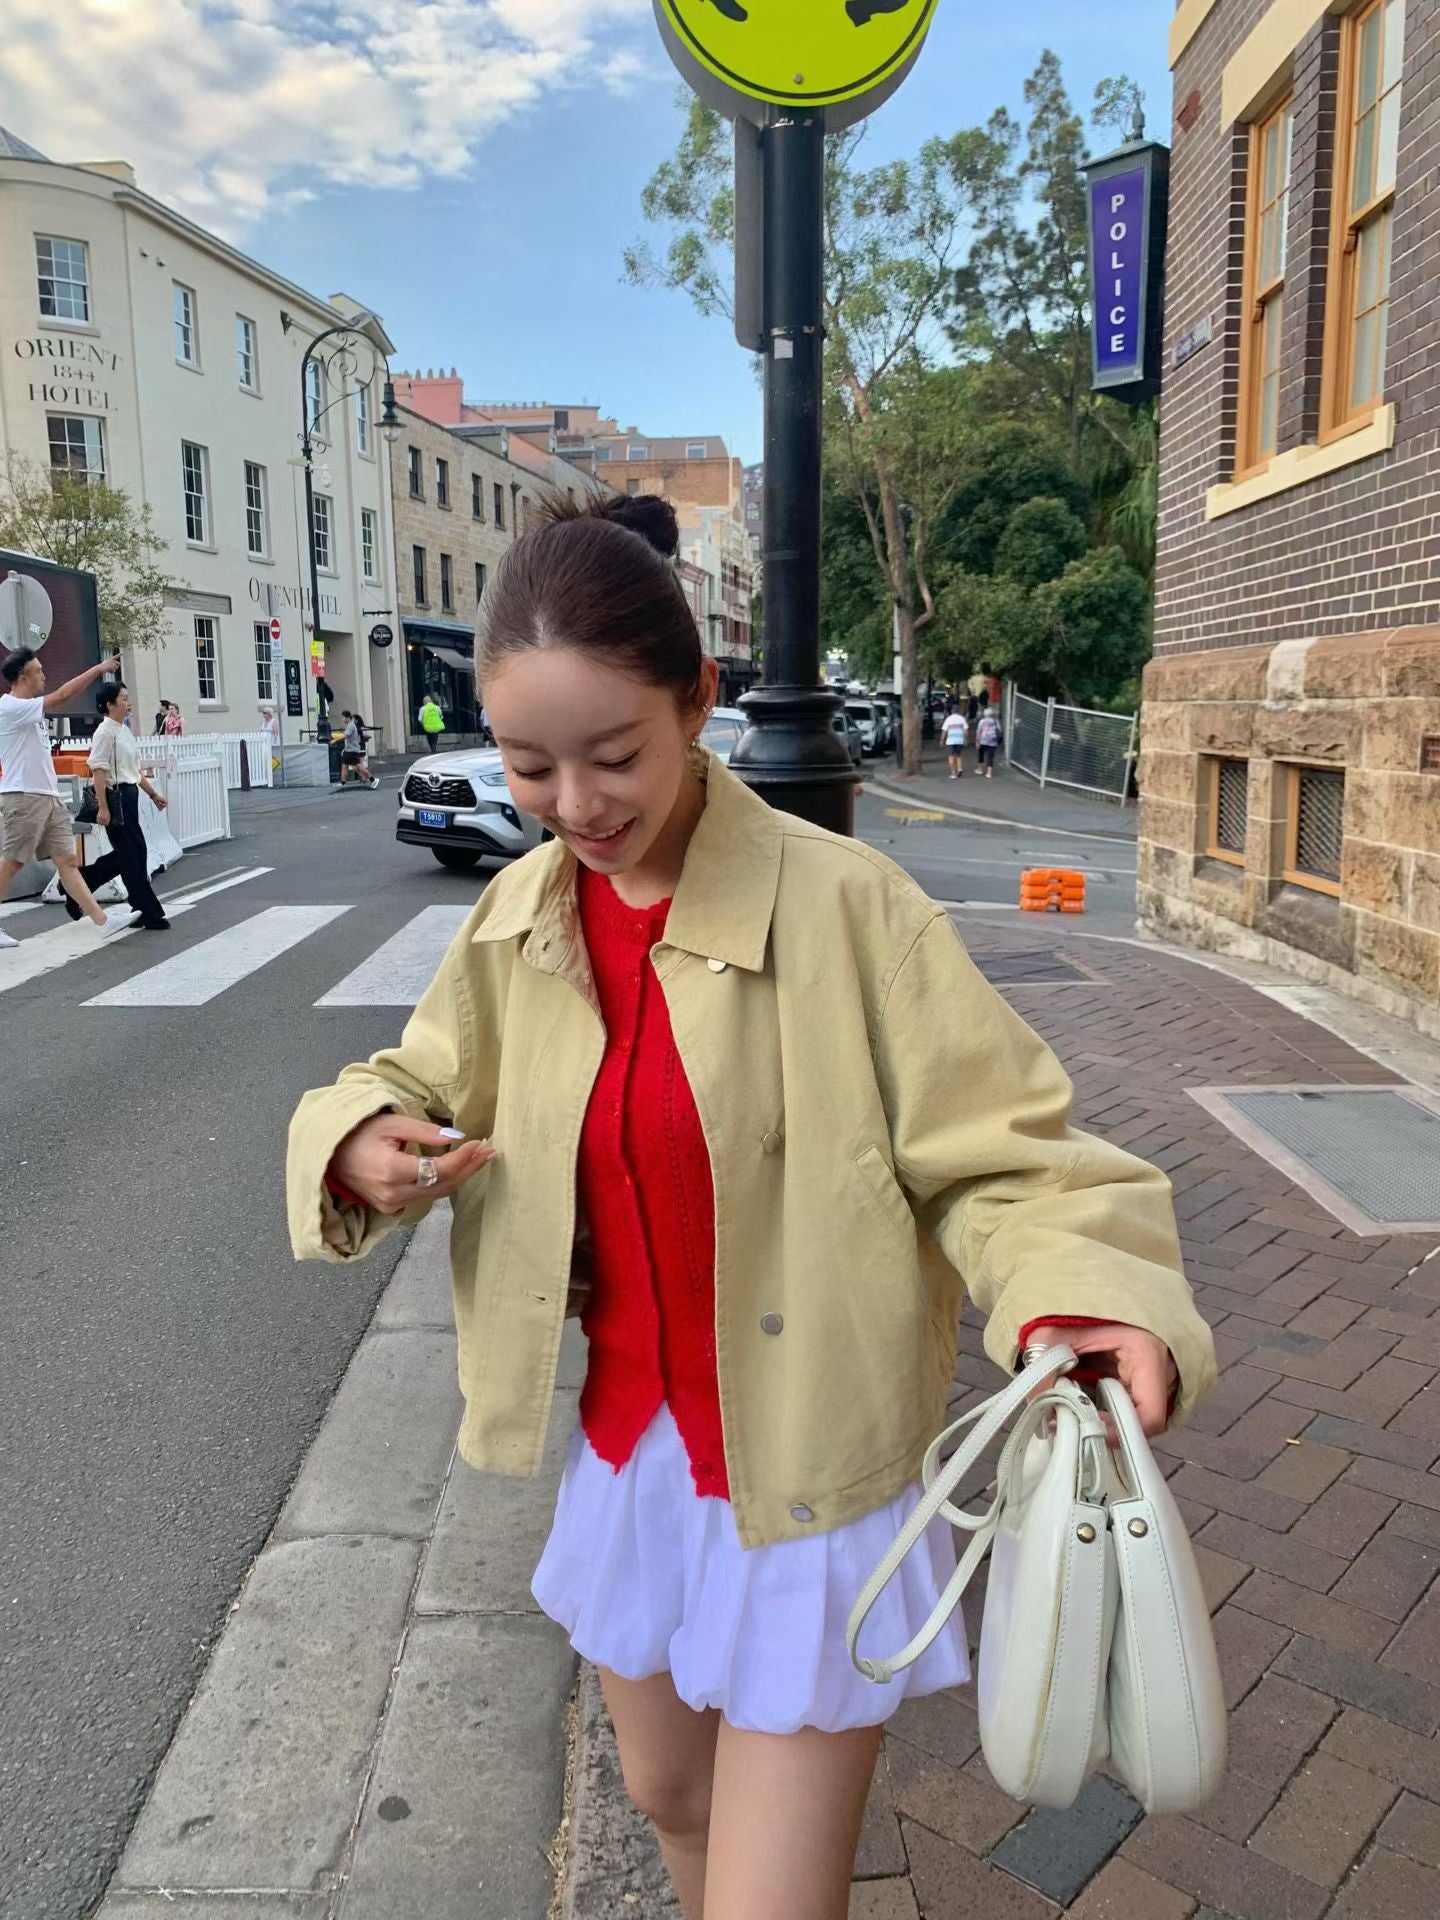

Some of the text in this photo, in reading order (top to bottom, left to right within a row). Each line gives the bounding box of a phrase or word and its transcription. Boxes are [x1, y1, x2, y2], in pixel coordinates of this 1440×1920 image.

[1109, 193, 1127, 353] POLICE
[15, 338, 123, 371] ORIENT
[29, 383, 118, 412] HOTEL
[249, 576, 342, 616] ONT HTEL
